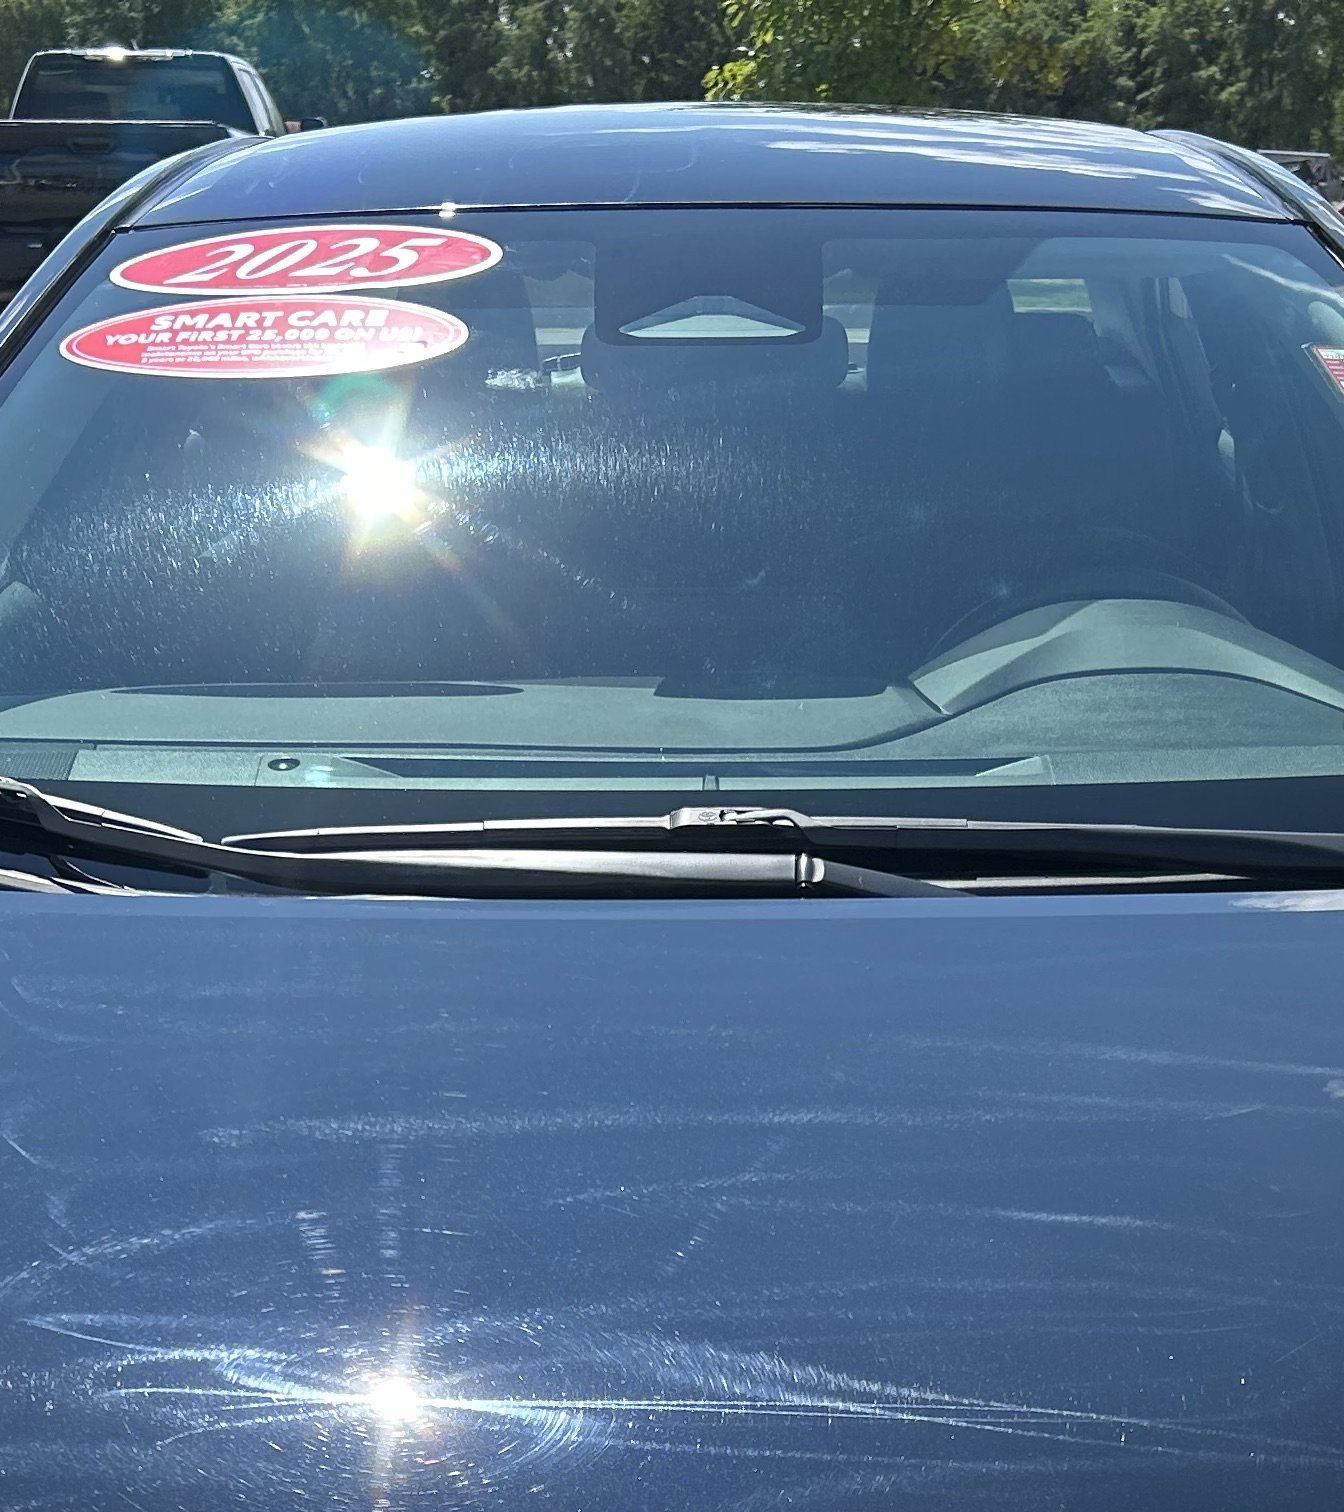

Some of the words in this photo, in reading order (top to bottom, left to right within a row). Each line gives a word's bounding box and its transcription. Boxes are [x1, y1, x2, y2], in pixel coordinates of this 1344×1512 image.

[163, 237, 449, 284] 2025
[151, 311, 284, 331] SMART
[287, 308, 390, 327] CARE
[105, 331, 174, 346] YOUR
[175, 329, 246, 343] FIRST
[245, 327, 330, 342] 25,000
[333, 327, 375, 341] ON
